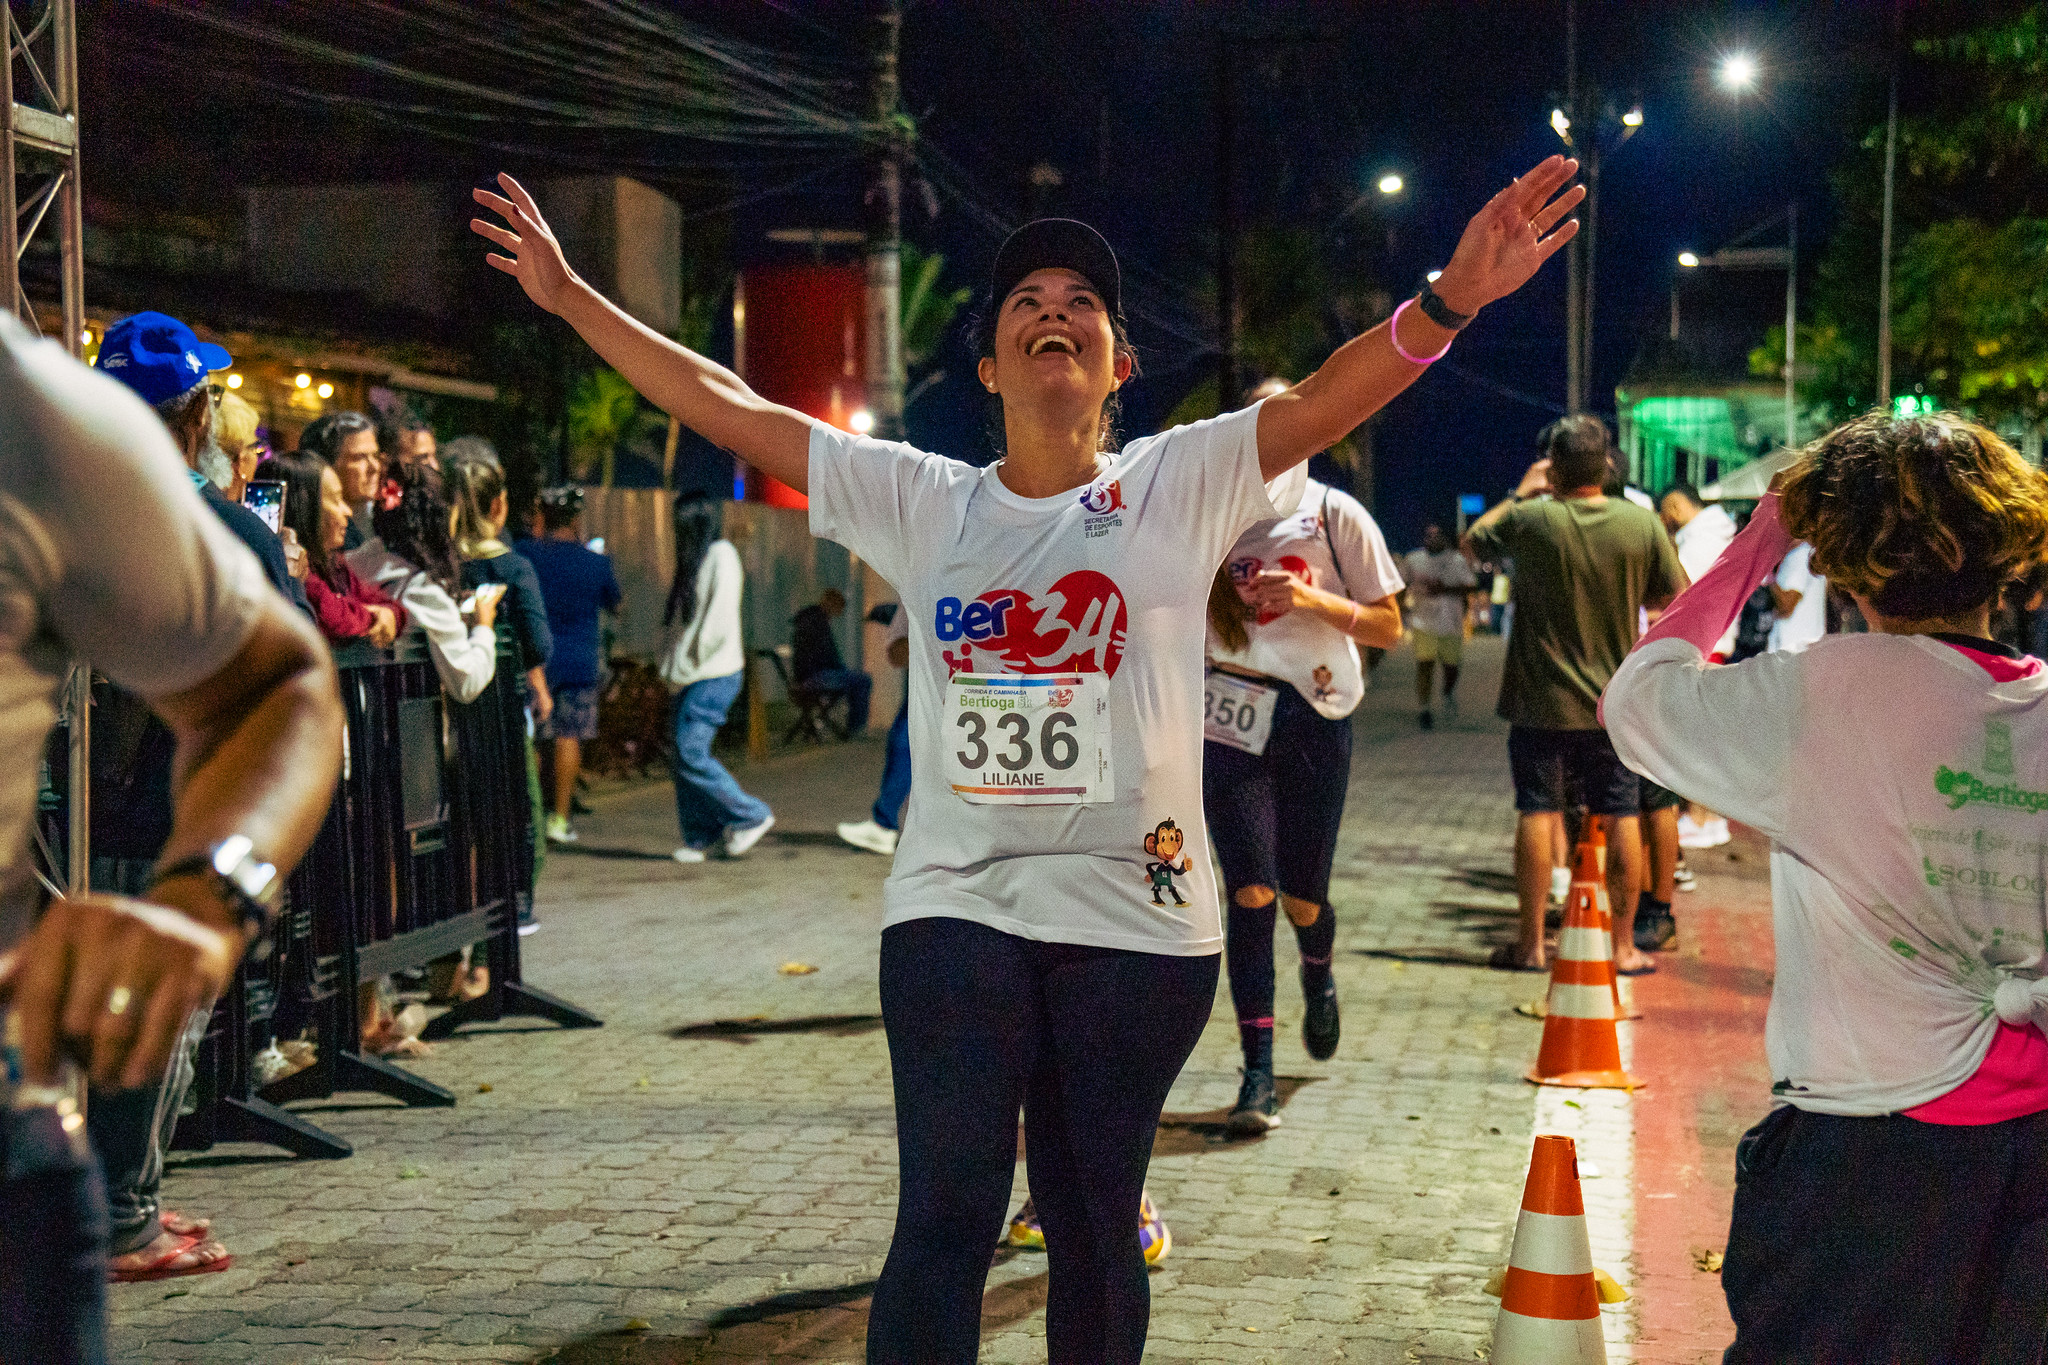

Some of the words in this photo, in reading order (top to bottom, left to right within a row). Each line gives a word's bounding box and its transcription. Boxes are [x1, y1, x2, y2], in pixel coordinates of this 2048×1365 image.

[1084, 513, 1118, 525] SECRETARIA
[1094, 519, 1122, 531] ESPORTES
[1090, 529, 1109, 538] LAZER
[935, 596, 1014, 642] Ber
[1025, 590, 1121, 673] 34
[960, 694, 1015, 711] Bertioga
[1205, 691, 1255, 732] 350
[956, 711, 1079, 771] 336
[983, 772, 1045, 786] LILIANE
[1969, 779, 2048, 814] Bertioga
